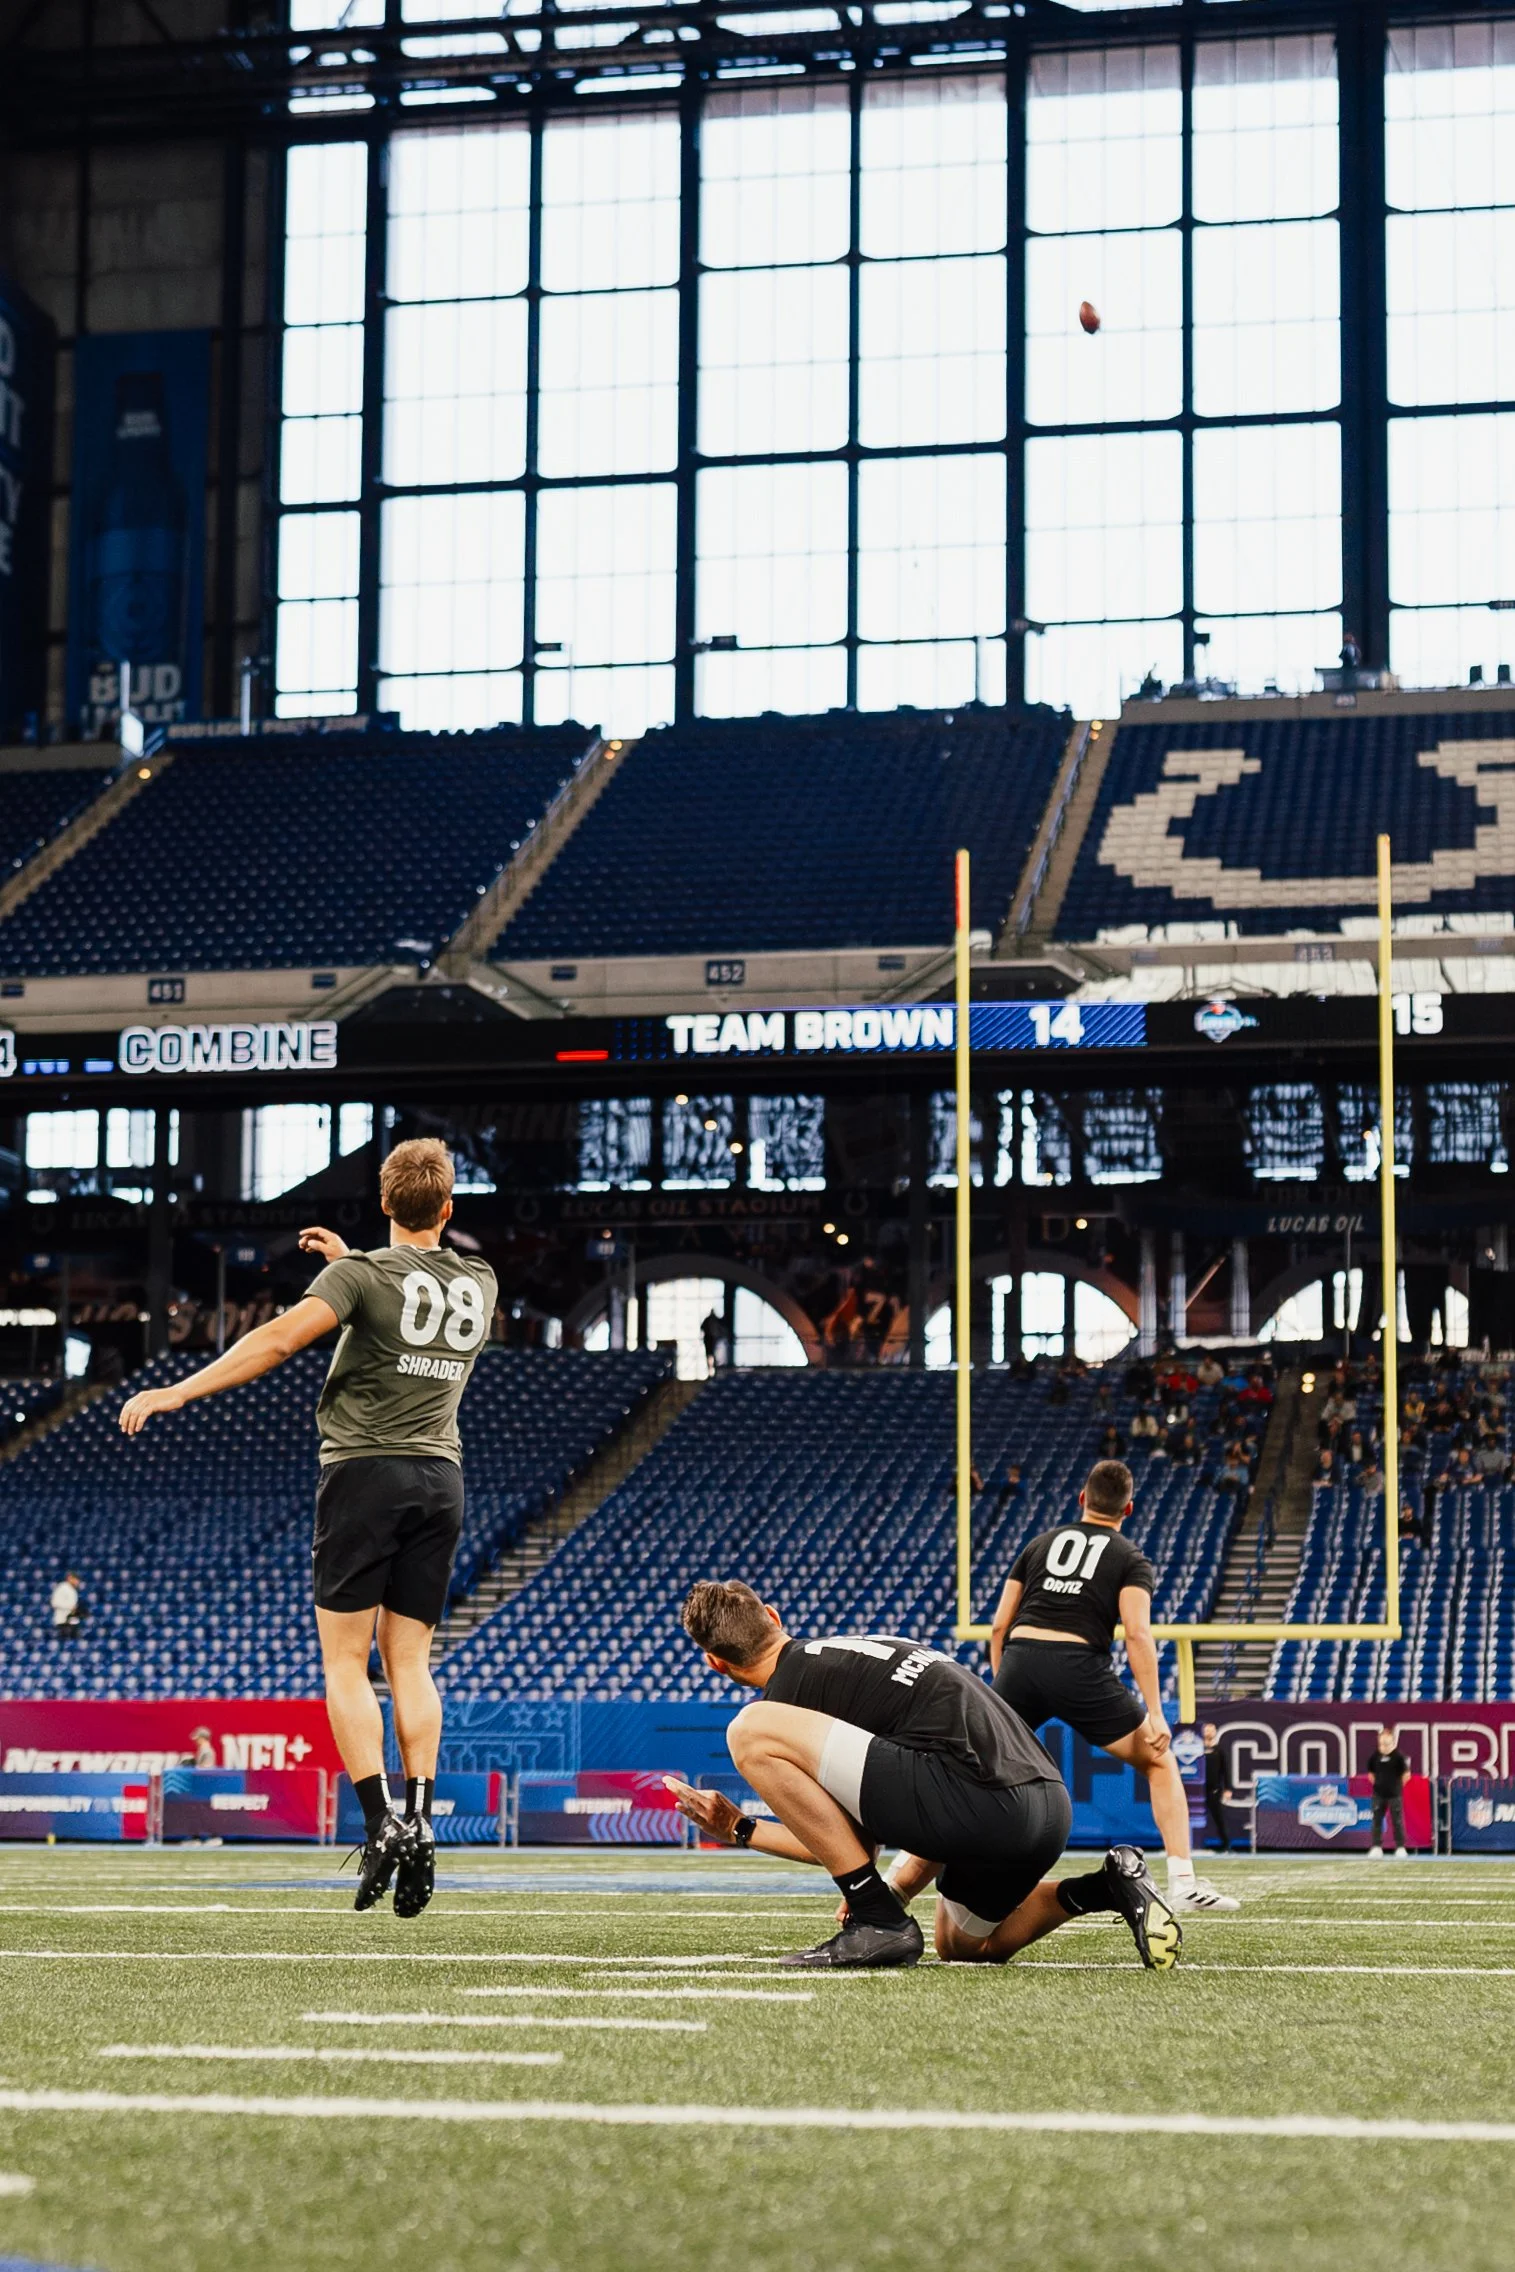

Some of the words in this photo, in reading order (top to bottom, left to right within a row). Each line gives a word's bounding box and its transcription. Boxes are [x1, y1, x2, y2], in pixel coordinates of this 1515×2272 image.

[708, 963, 744, 983] 452
[664, 1011, 787, 1055] TEAM
[793, 1008, 955, 1052] BROWN
[1028, 1004, 1085, 1046] 14
[1391, 992, 1444, 1035] 15
[118, 1020, 339, 1074] COMBINE
[560, 1198, 641, 1219] LUCAS
[647, 1197, 692, 1217] OIL
[698, 1195, 821, 1217] STADIUM
[1266, 1213, 1331, 1234] LUCAS
[399, 1270, 486, 1352] 08
[396, 1353, 466, 1382] SHRADER
[1045, 1528, 1112, 1581] 01
[1043, 1576, 1084, 1596] ORTIZ
